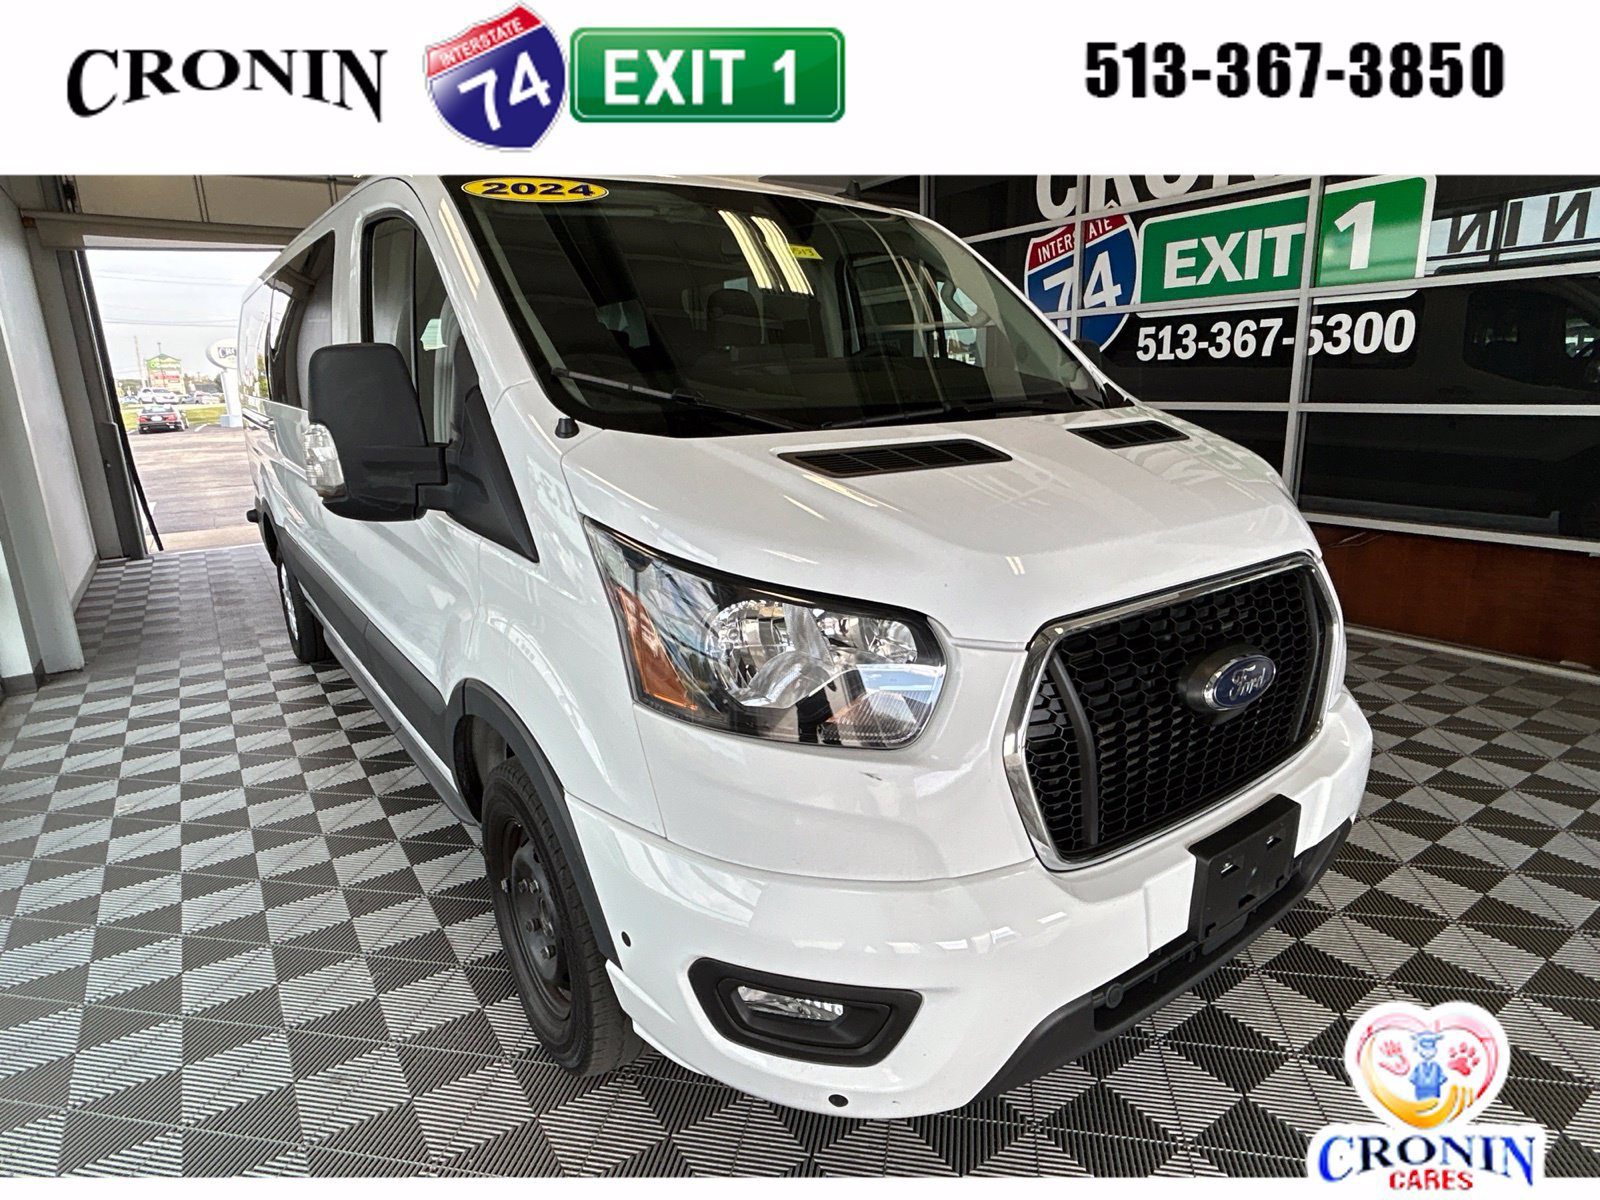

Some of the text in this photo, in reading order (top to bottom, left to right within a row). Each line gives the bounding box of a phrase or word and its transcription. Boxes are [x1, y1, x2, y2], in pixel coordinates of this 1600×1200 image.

[480, 182, 595, 197] 2024
[1037, 218, 1113, 263] INTERATE
[1163, 200, 1376, 290] EXIT 1
[1042, 250, 1123, 333] 74
[1135, 309, 1416, 363] 513-367-5300
[1229, 664, 1266, 700] Ford
